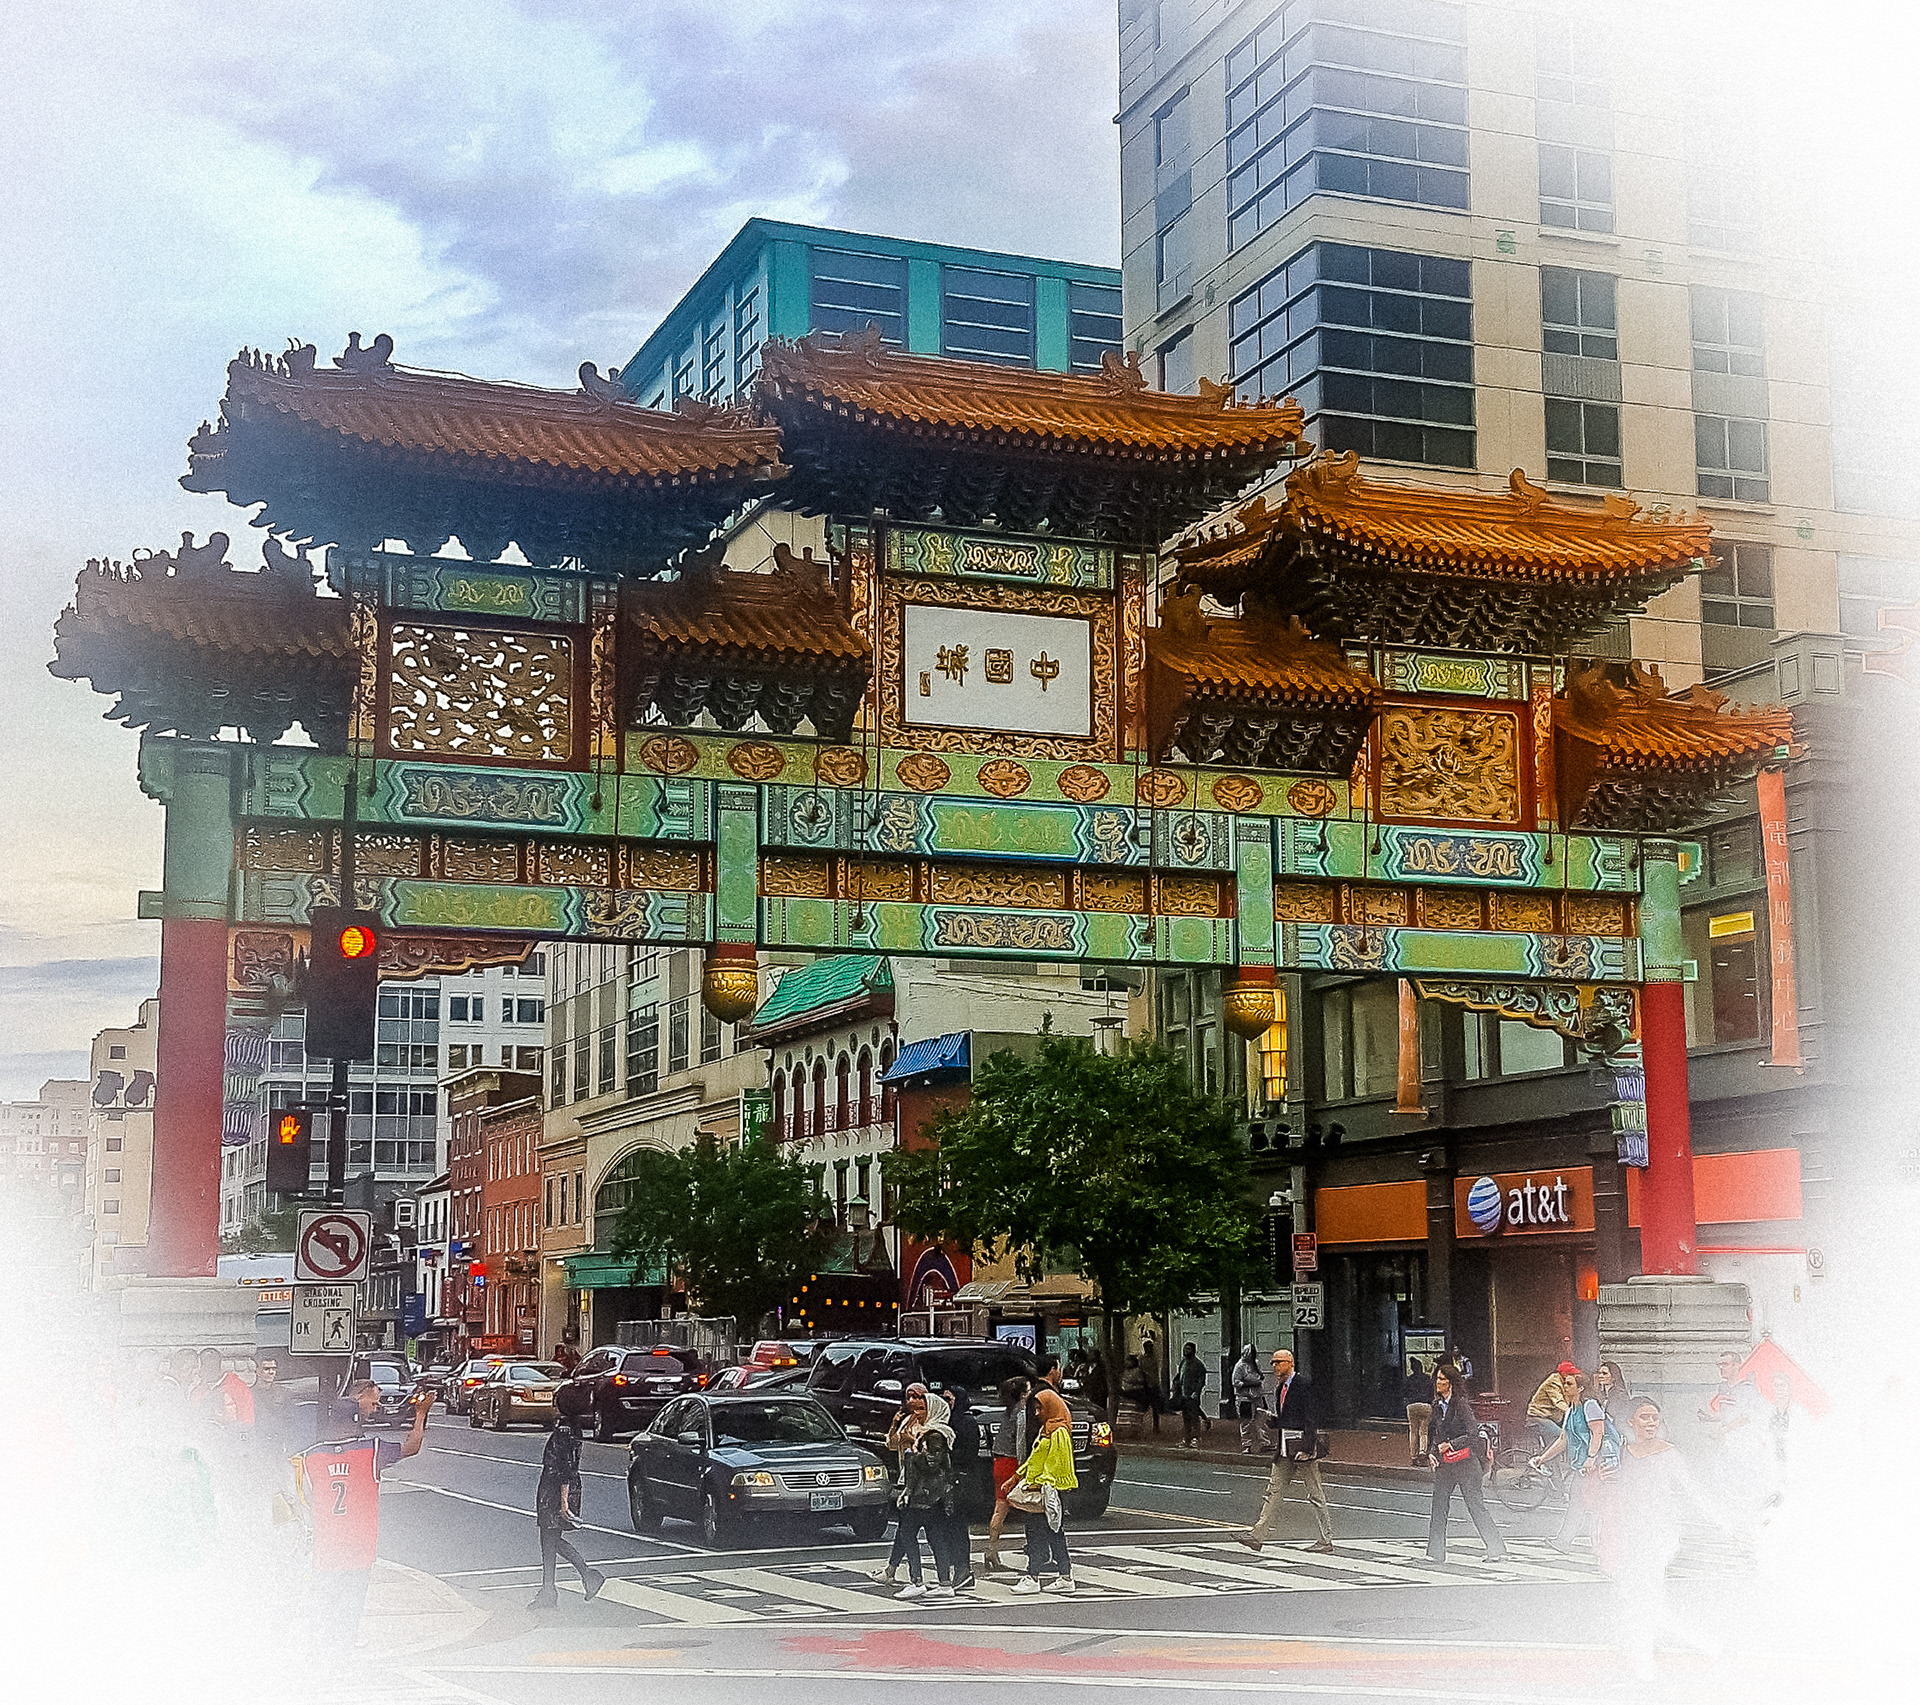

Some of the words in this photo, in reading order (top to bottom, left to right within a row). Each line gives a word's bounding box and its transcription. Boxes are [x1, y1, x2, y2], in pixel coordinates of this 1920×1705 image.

[743, 1103, 751, 1146] CHINA
[1508, 1176, 1568, 1225] at&t
[303, 1298, 341, 1307] CROSSING
[1295, 1307, 1319, 1325] 25
[295, 1322, 310, 1335] OK
[327, 1463, 350, 1477] WALL
[330, 1480, 348, 1516] 2
